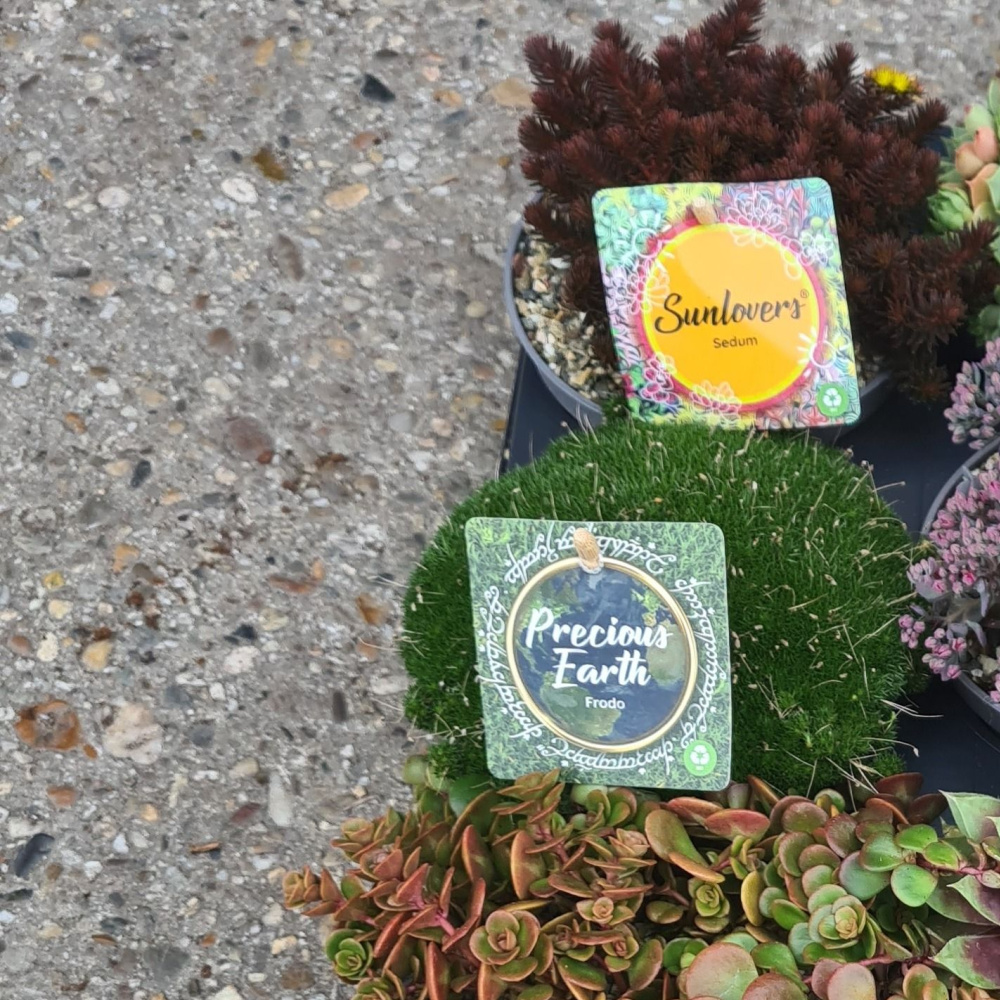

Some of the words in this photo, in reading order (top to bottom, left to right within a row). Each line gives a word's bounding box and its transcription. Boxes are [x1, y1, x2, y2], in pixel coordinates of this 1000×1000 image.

[654, 289, 807, 333] Sunlovers
[713, 336, 758, 349] Sedum
[525, 607, 673, 648] Precious
[552, 646, 652, 689] Earth
[585, 697, 626, 710] Frodo
